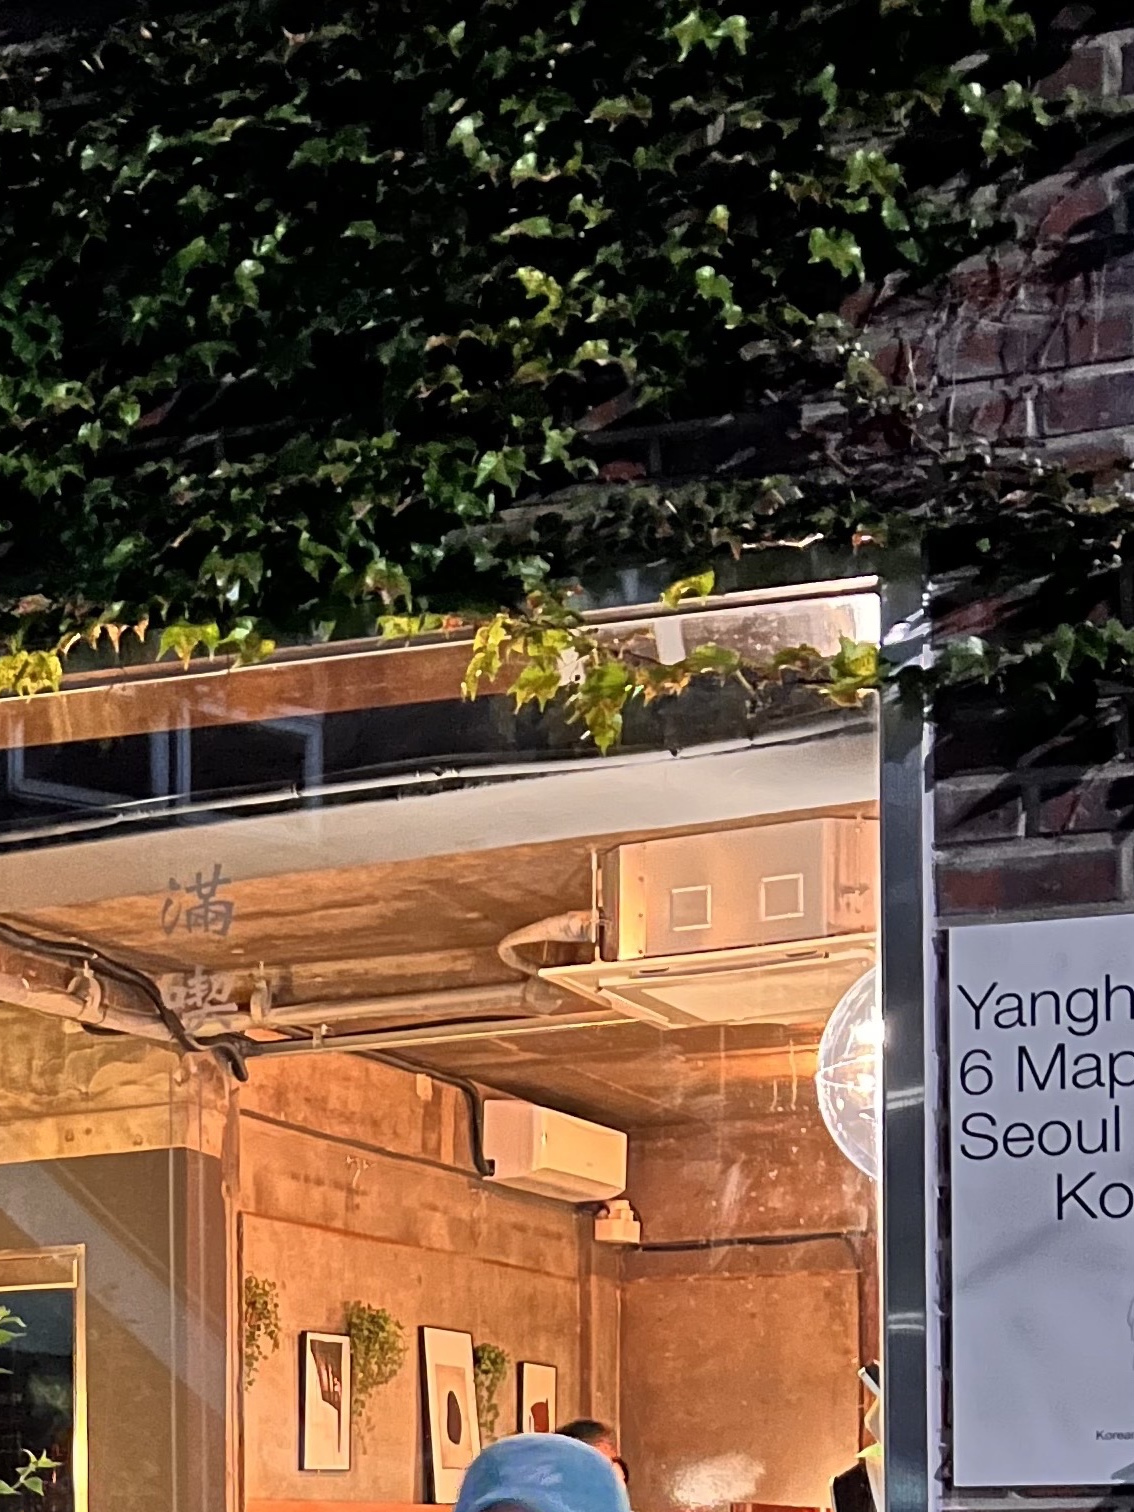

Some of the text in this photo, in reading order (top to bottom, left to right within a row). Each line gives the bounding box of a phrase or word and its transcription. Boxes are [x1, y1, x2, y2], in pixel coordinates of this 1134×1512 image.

[957, 974, 1134, 1037] Yangh
[960, 1043, 1134, 1099] 6 Map
[960, 1105, 1120, 1161] Seoul
[1057, 1171, 1134, 1220] Ko
